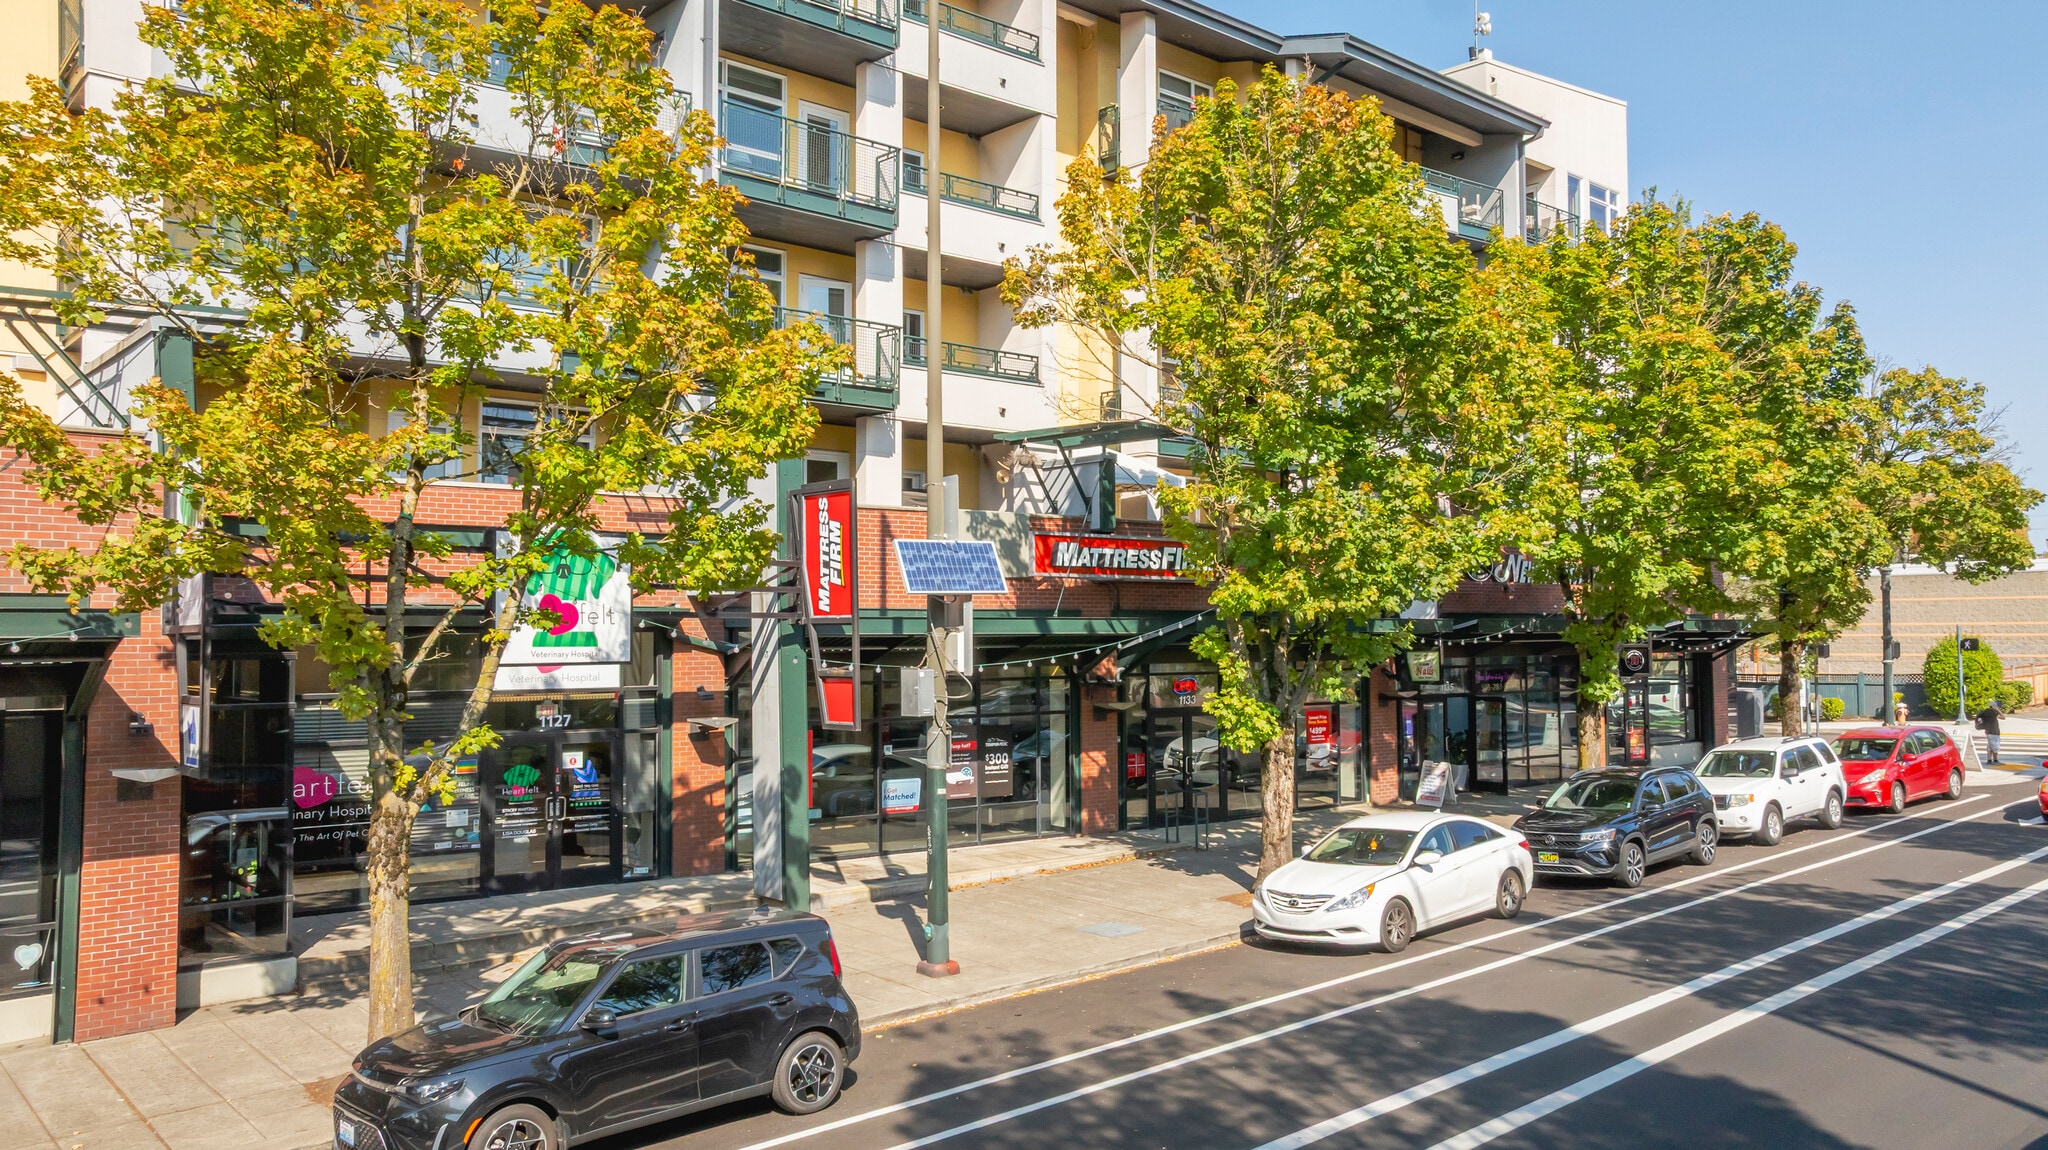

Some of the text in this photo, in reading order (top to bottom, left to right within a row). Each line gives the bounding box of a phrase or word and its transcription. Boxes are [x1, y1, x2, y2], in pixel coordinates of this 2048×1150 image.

[818, 497, 830, 612] MATTRESS
[829, 520, 842, 586] FIRM
[1056, 541, 1188, 570] MATTRESSFI
[530, 650, 569, 659] Veterinary
[508, 671, 601, 684] Veterinary Hospital
[1172, 680, 1197, 692] OPEN
[1179, 695, 1197, 705] 1133
[539, 714, 572, 728] 1127
[985, 752, 1009, 765] $300
[502, 785, 540, 797] Heartfelt
[293, 803, 373, 821] inary Hospit
[299, 833, 315, 842] The
[316, 832, 330, 840] Art
[332, 830, 345, 841] Of
[346, 830, 359, 838] Pet
